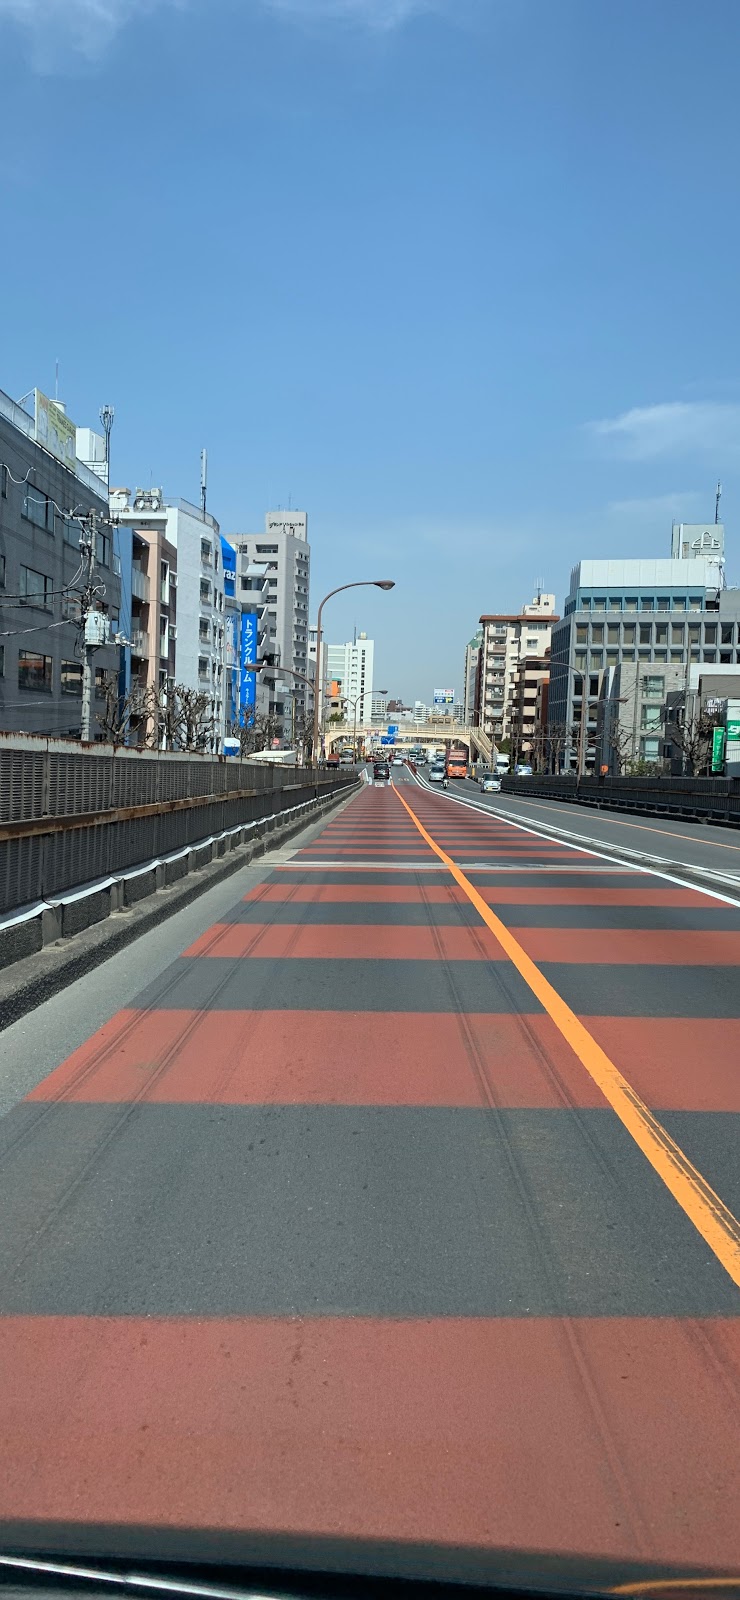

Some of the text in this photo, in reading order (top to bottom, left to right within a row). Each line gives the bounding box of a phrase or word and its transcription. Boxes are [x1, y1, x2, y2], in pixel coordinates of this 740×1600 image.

[243, 619, 252, 682] トランクルム
